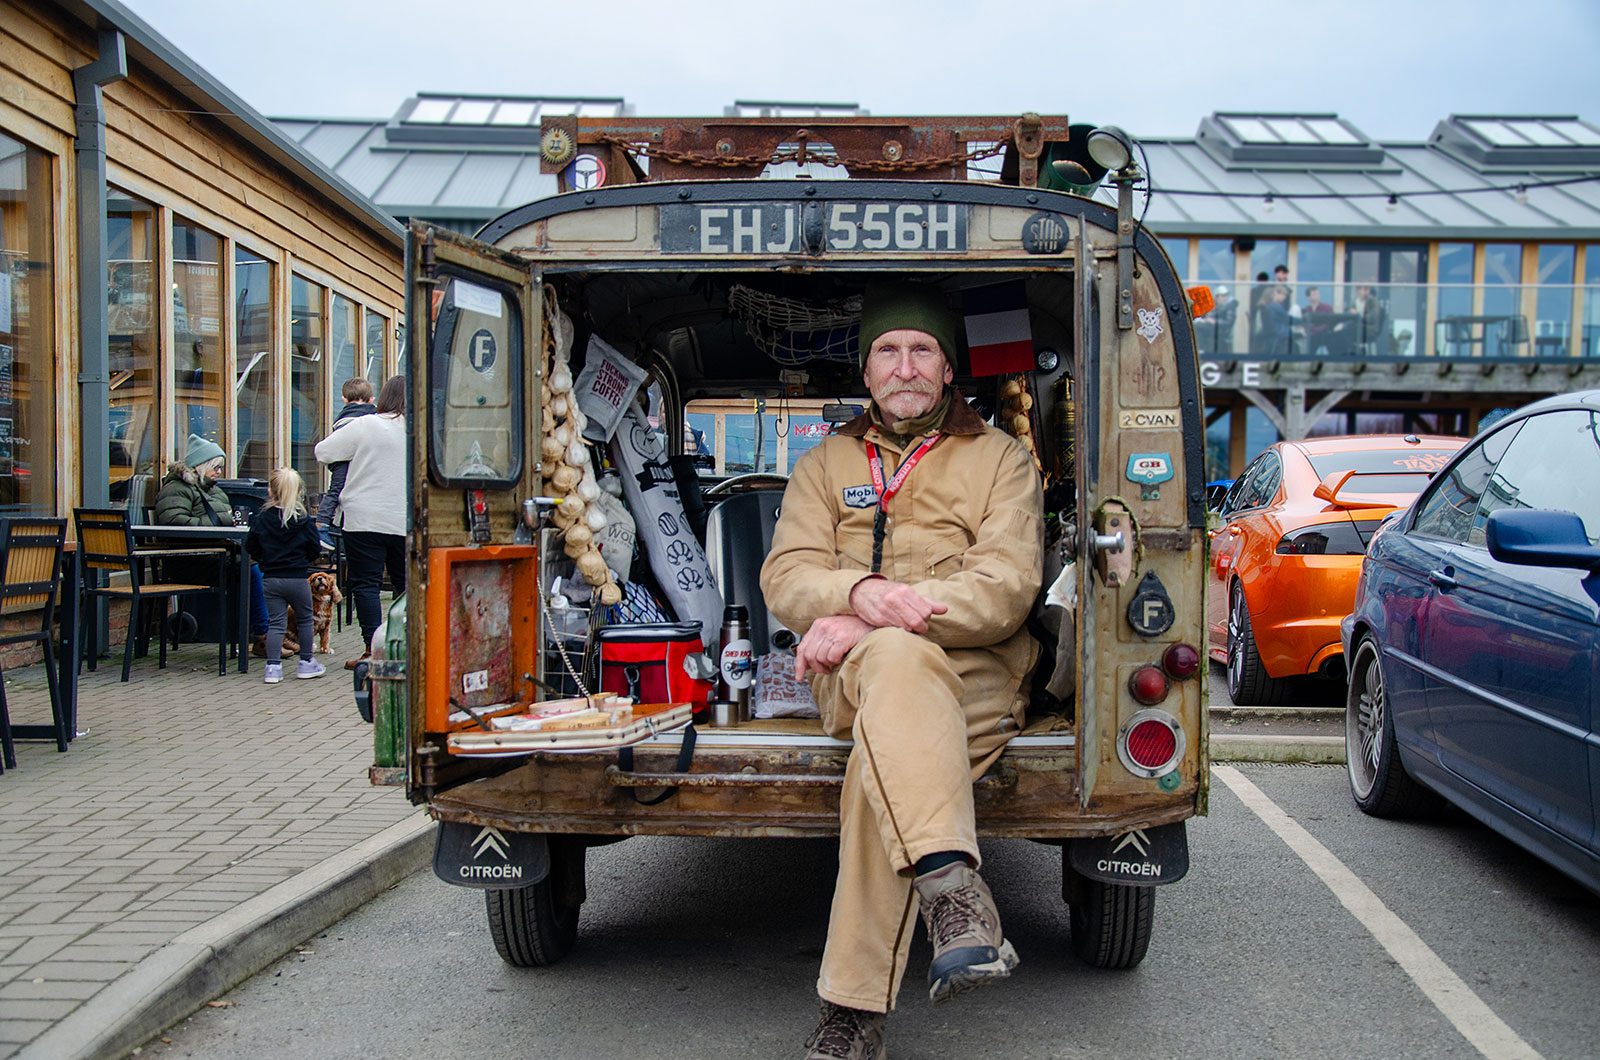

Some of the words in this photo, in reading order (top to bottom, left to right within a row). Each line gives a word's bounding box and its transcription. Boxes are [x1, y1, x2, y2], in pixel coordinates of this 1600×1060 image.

[700, 208, 794, 253] EHJ
[829, 204, 956, 249] 556H
[1031, 217, 1063, 252] STOP
[475, 335, 492, 368] F
[597, 369, 626, 397] STRONG
[600, 359, 629, 387] FUCKING
[592, 380, 621, 407] COFFEE
[1123, 415, 1131, 426] 2
[1135, 414, 1175, 426] CVAN
[1139, 460, 1161, 469] GB
[1143, 600, 1163, 627] F
[460, 864, 522, 878] CITROËN
[1097, 860, 1161, 876] CITROËN
